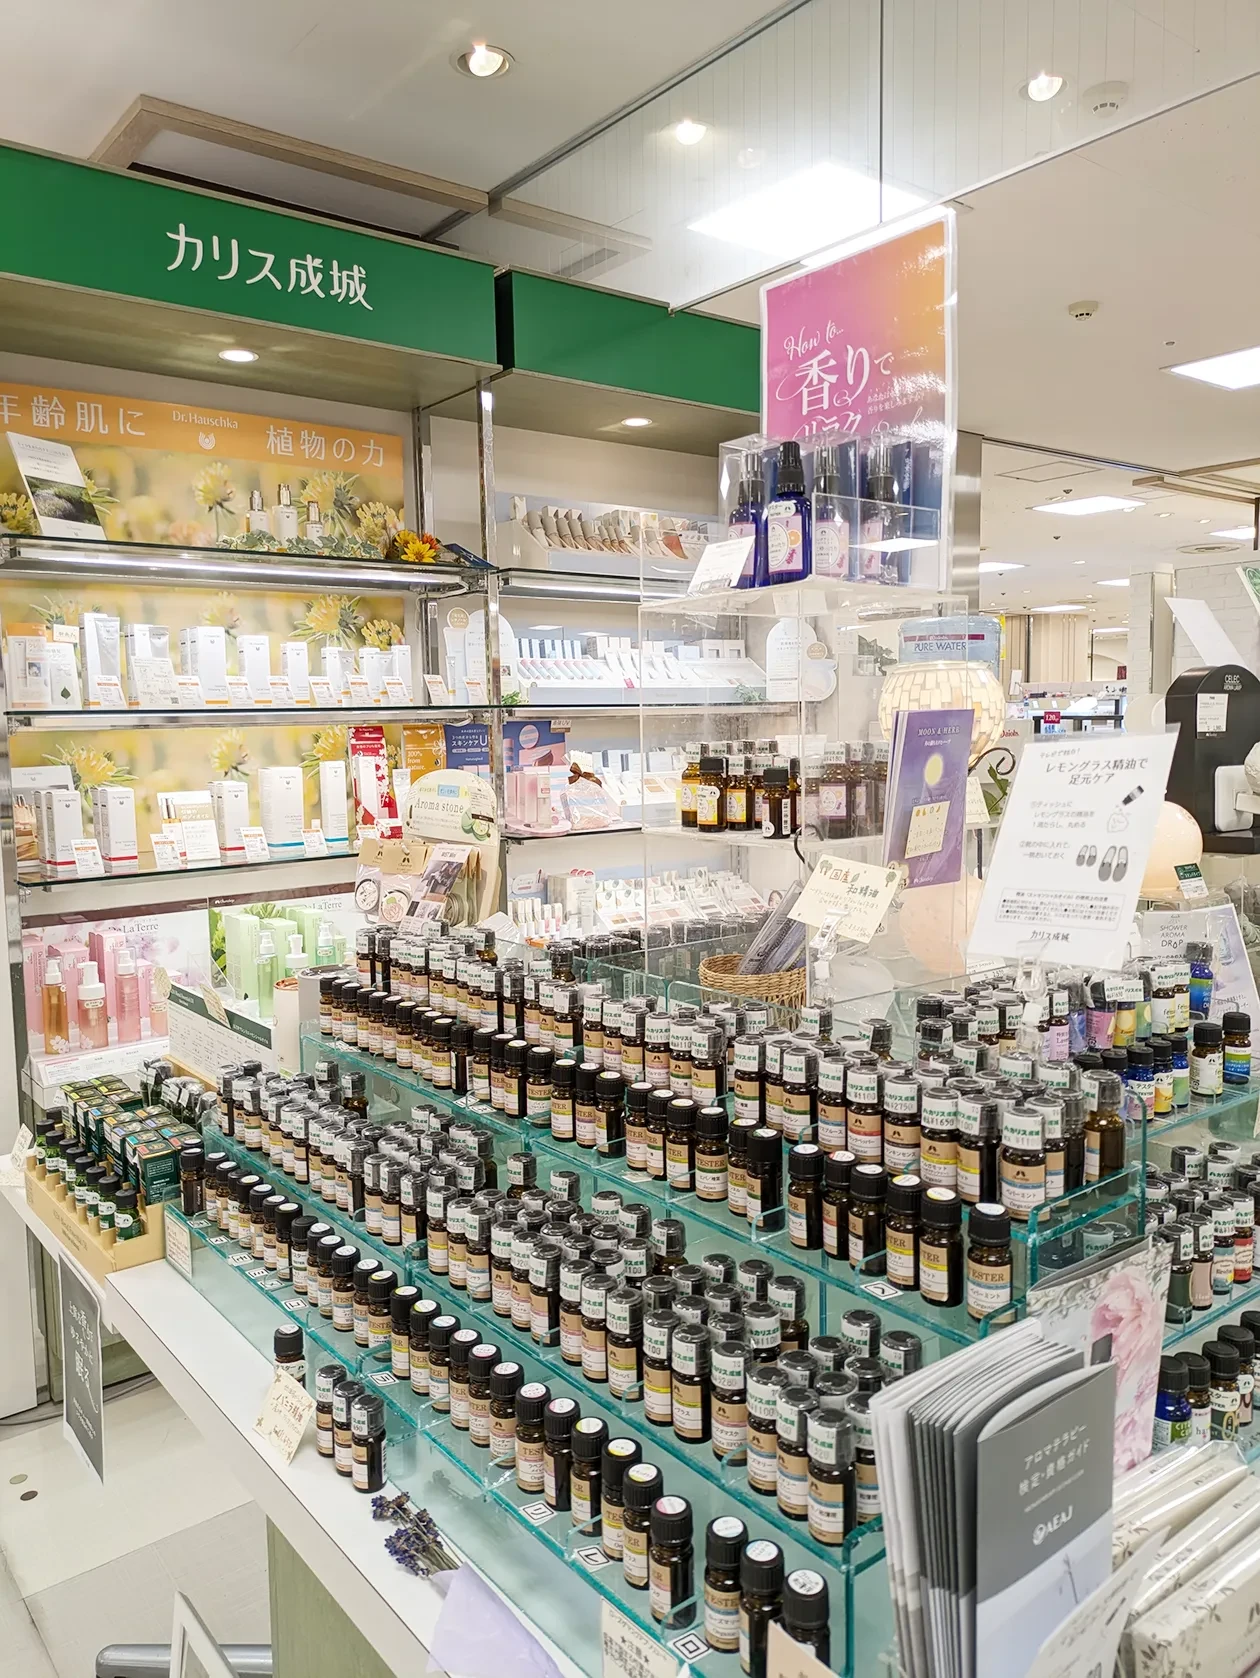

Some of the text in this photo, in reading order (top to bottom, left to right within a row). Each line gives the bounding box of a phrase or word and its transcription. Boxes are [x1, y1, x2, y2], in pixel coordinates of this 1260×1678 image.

[166, 223, 373, 310] カリス成城
[784, 327, 820, 360] How
[776, 344, 895, 416] 香りで
[172, 410, 239, 429] Dr.Hauschka
[265, 425, 385, 468] 植物の力
[914, 641, 967, 652] PURE WATER
[1046, 758, 1148, 773] レモングラス精油で
[1068, 773, 1115, 785] 足元ケア
[414, 799, 464, 813] Aroma stone
[1030, 930, 1071, 942] カリス成城
[697, 1158, 725, 1167] TESTER
[1024, 1424, 1087, 1471] アロマテラピー
[1045, 1505, 1073, 1536] AEAJ
